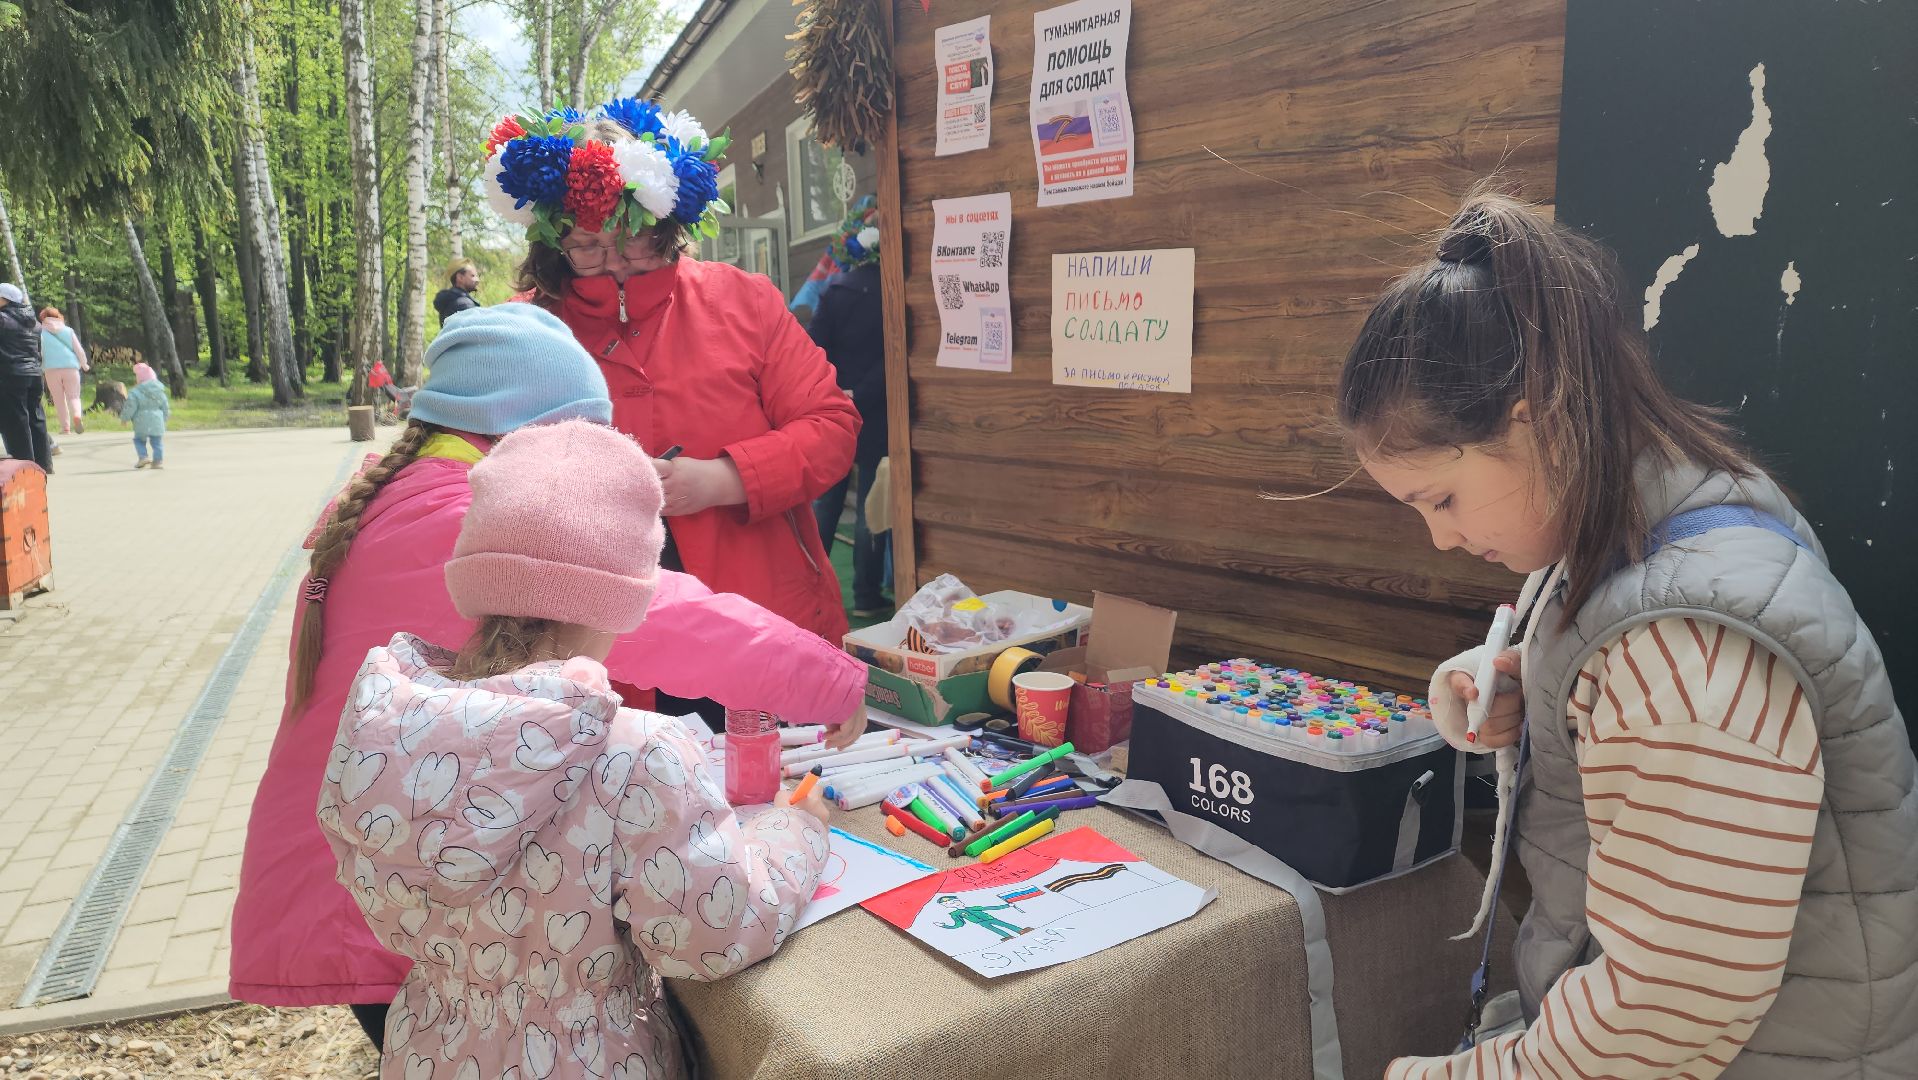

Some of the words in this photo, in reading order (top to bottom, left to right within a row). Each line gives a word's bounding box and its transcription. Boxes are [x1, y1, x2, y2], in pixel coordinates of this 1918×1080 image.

[1044, 9, 1121, 42] ГУМАНИТАРНАЯ
[1046, 38, 1112, 73] ПОМОЩЬ
[1040, 79, 1063, 102] ДЛЯ
[1066, 67, 1115, 93] СОЛДАТ
[937, 245, 976, 257] ВКонтакте
[1068, 255, 1152, 277] НАПИШИ
[962, 280, 1000, 294] WhatsApp
[1066, 290, 1143, 311] ПИСЬМО
[946, 332, 978, 346] Telegram
[1064, 317, 1169, 344] СОЛДАТУ
[1063, 366, 1076, 378] ЗА
[1081, 368, 1121, 380] ПИСЬМО
[1189, 757, 1255, 805] 168
[1191, 794, 1251, 824] COLORS
[981, 952, 1012, 968] 9
